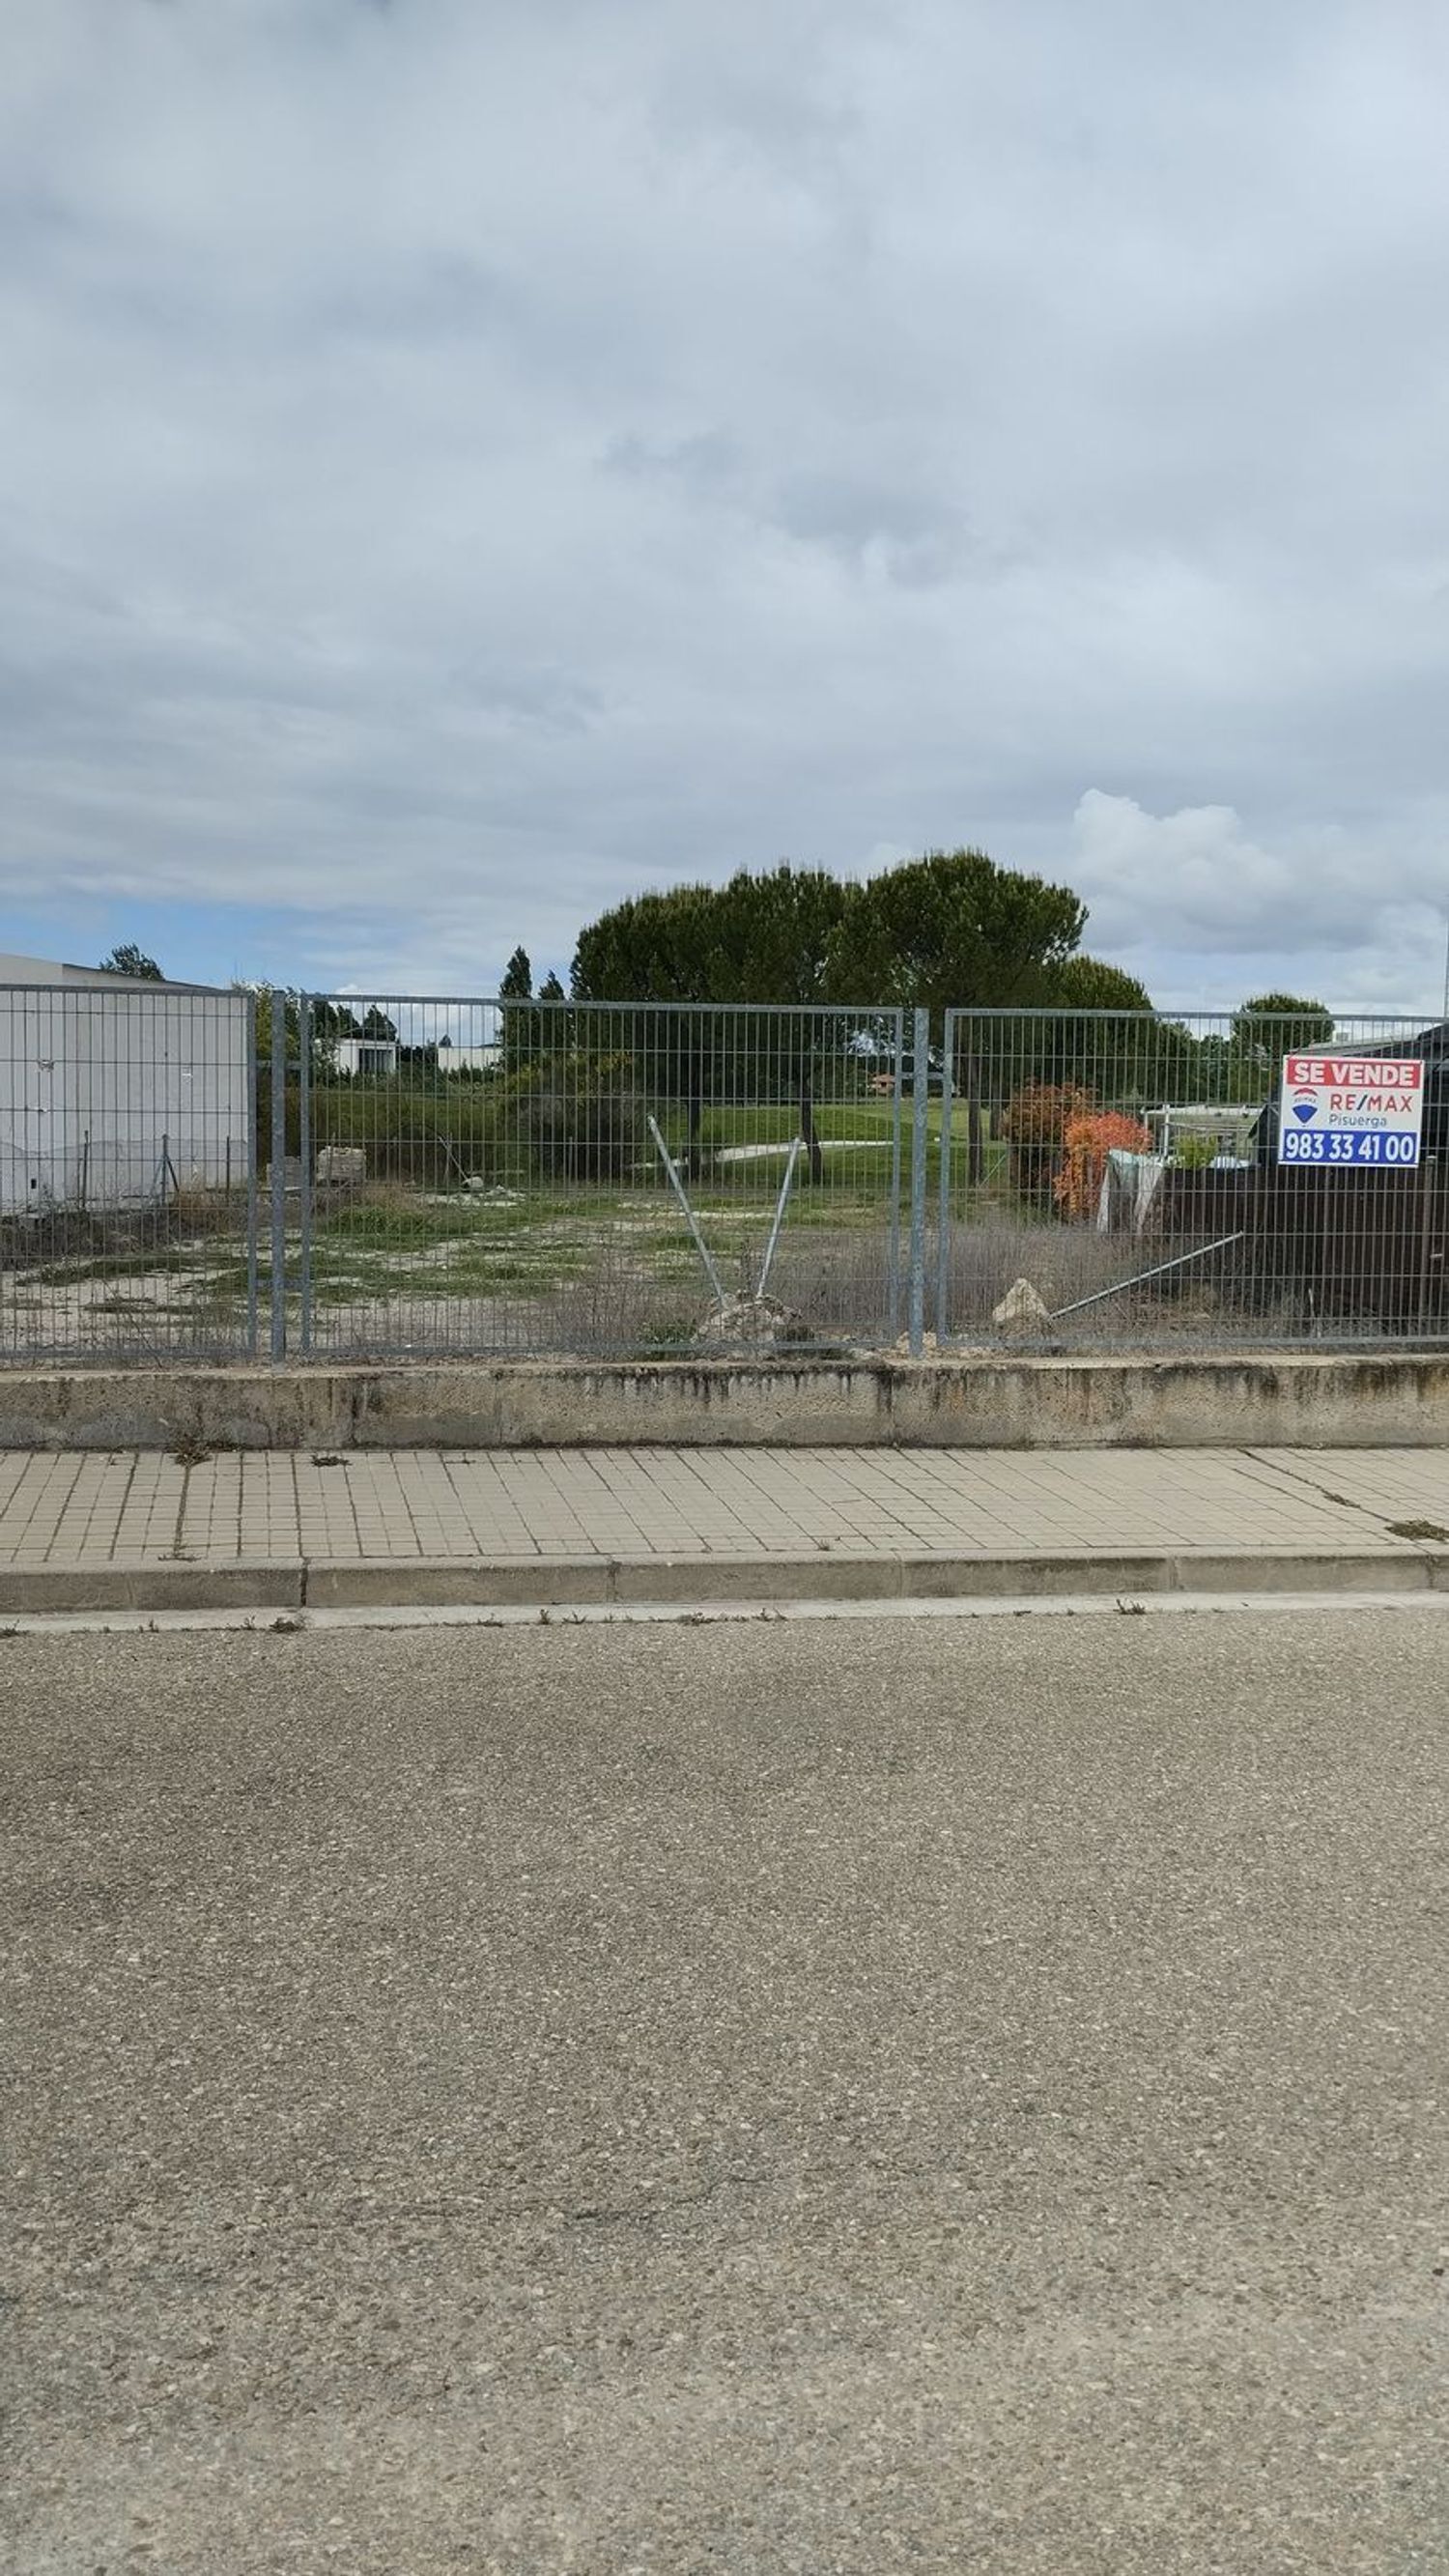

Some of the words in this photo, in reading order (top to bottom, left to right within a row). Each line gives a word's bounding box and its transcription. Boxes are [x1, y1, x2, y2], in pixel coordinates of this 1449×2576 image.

[1294, 1062, 1324, 1083] SE
[1331, 1064, 1414, 1086] VENDE
[1330, 1093, 1412, 1112] RE/MAX
[1329, 1114, 1387, 1129] Pisuerga
[1286, 1132, 1324, 1159] 983
[1329, 1134, 1354, 1159] 33
[1358, 1135, 1379, 1160] 41
[1385, 1135, 1414, 1161] 00
